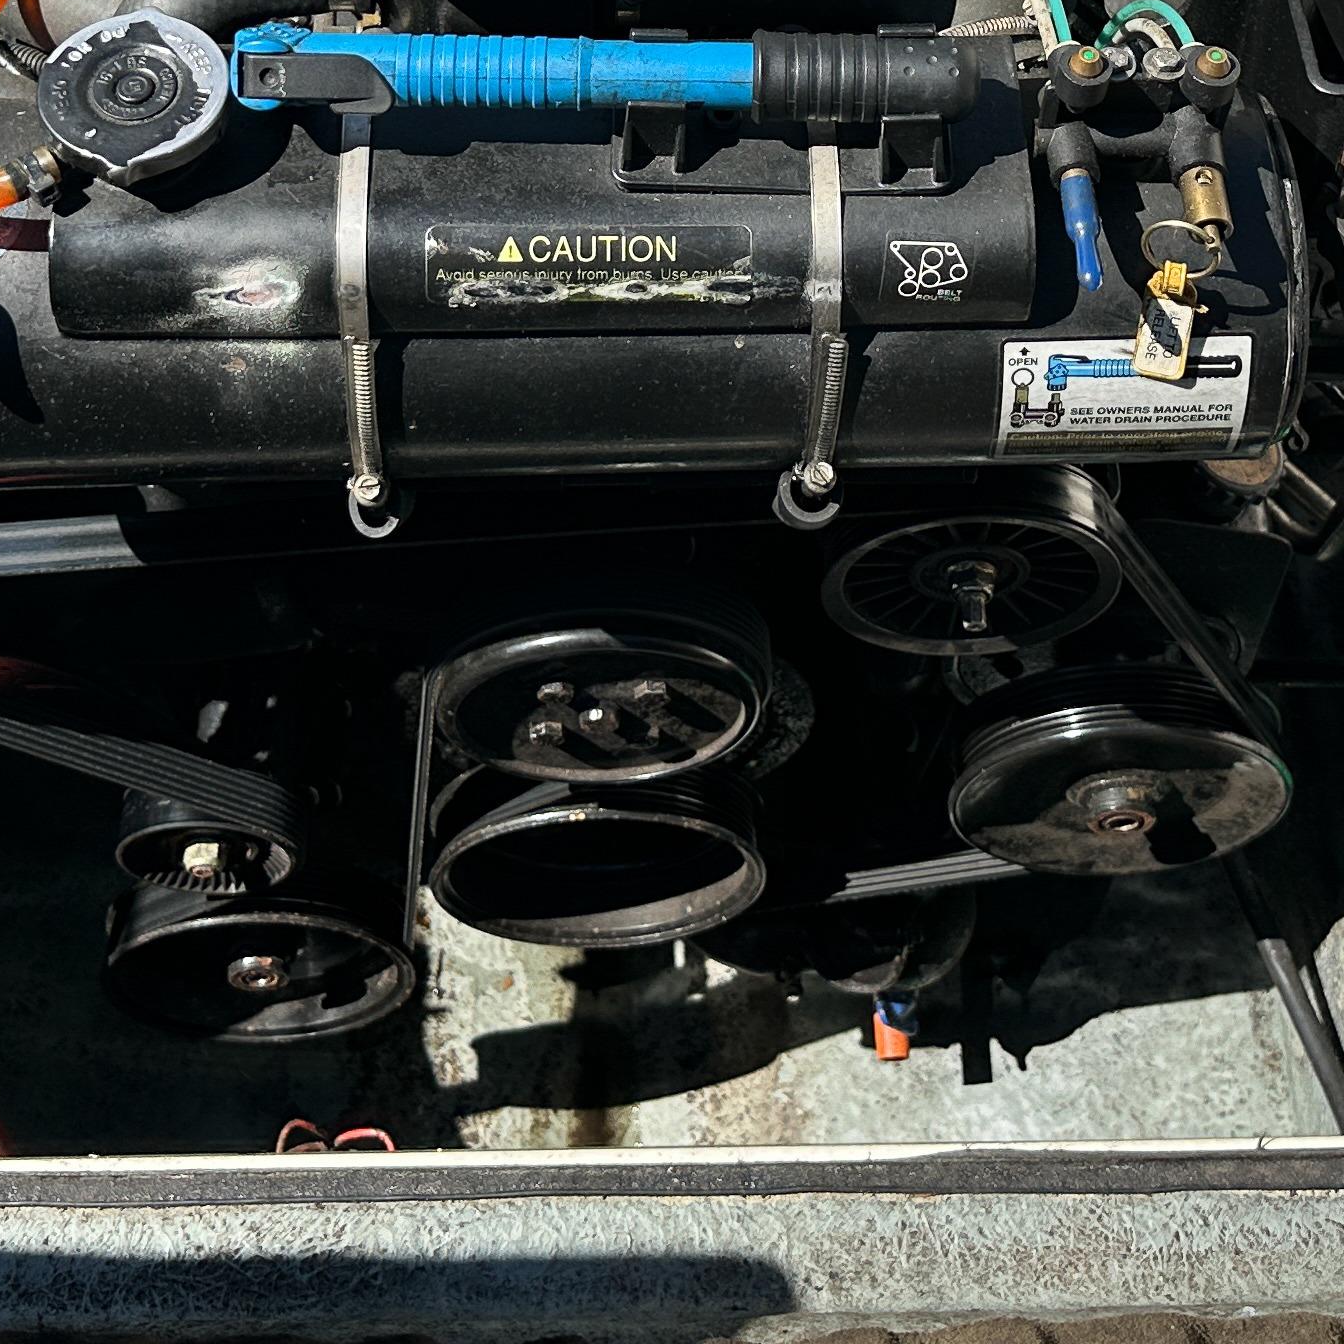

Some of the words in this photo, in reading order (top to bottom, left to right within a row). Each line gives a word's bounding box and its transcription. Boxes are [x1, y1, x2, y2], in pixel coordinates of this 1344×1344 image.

[528, 235, 677, 263] CAUTION
[435, 267, 475, 281] Avoid
[576, 267, 609, 280] from
[660, 267, 689, 281] Use
[1145, 309, 1165, 360] RELEASE
[1009, 357, 1038, 366] OPEN
[1070, 407, 1093, 416] SEE
[1098, 406, 1150, 415] OWNERS
[1154, 405, 1205, 414] MANUAL
[1208, 404, 1233, 413] FOR
[1070, 415, 1111, 425] WATER
[1114, 414, 1152, 423] DRAIN
[1155, 413, 1231, 423] PROCEDURE
